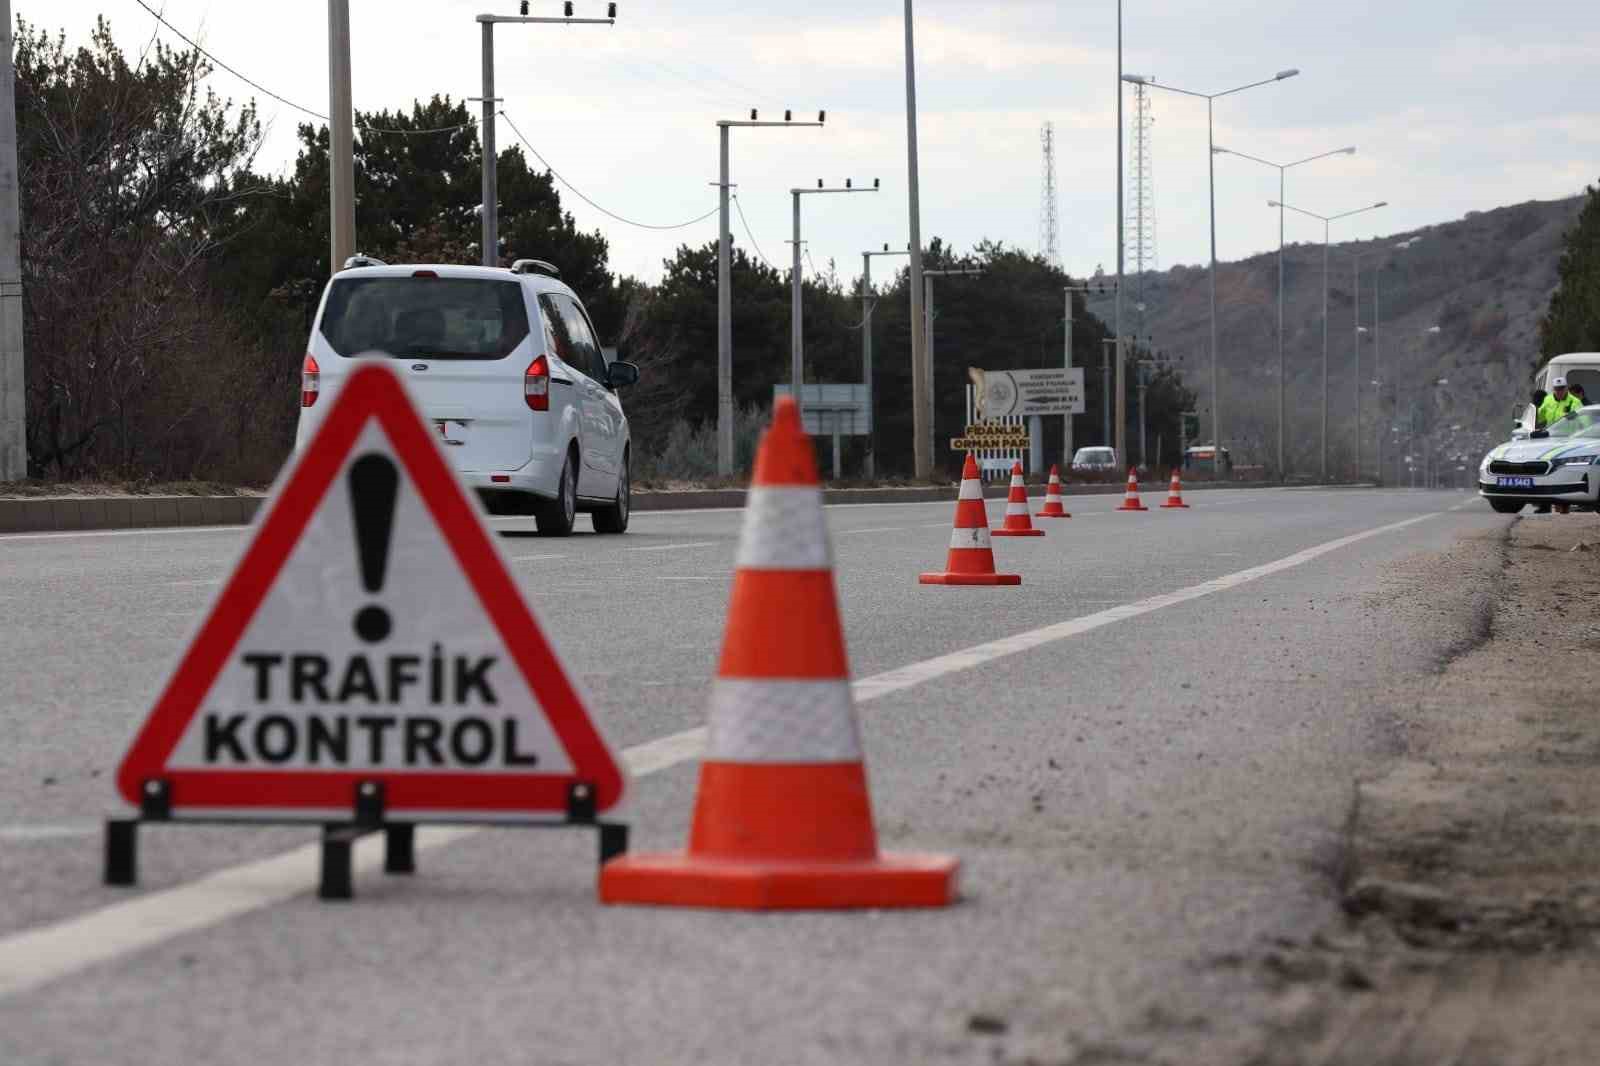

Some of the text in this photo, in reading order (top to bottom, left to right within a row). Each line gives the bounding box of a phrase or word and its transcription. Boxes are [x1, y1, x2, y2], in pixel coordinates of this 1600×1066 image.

[953, 438, 999, 449] ORMAN
[242, 642, 498, 705] TRAFİK
[204, 714, 538, 767] KONTROL
